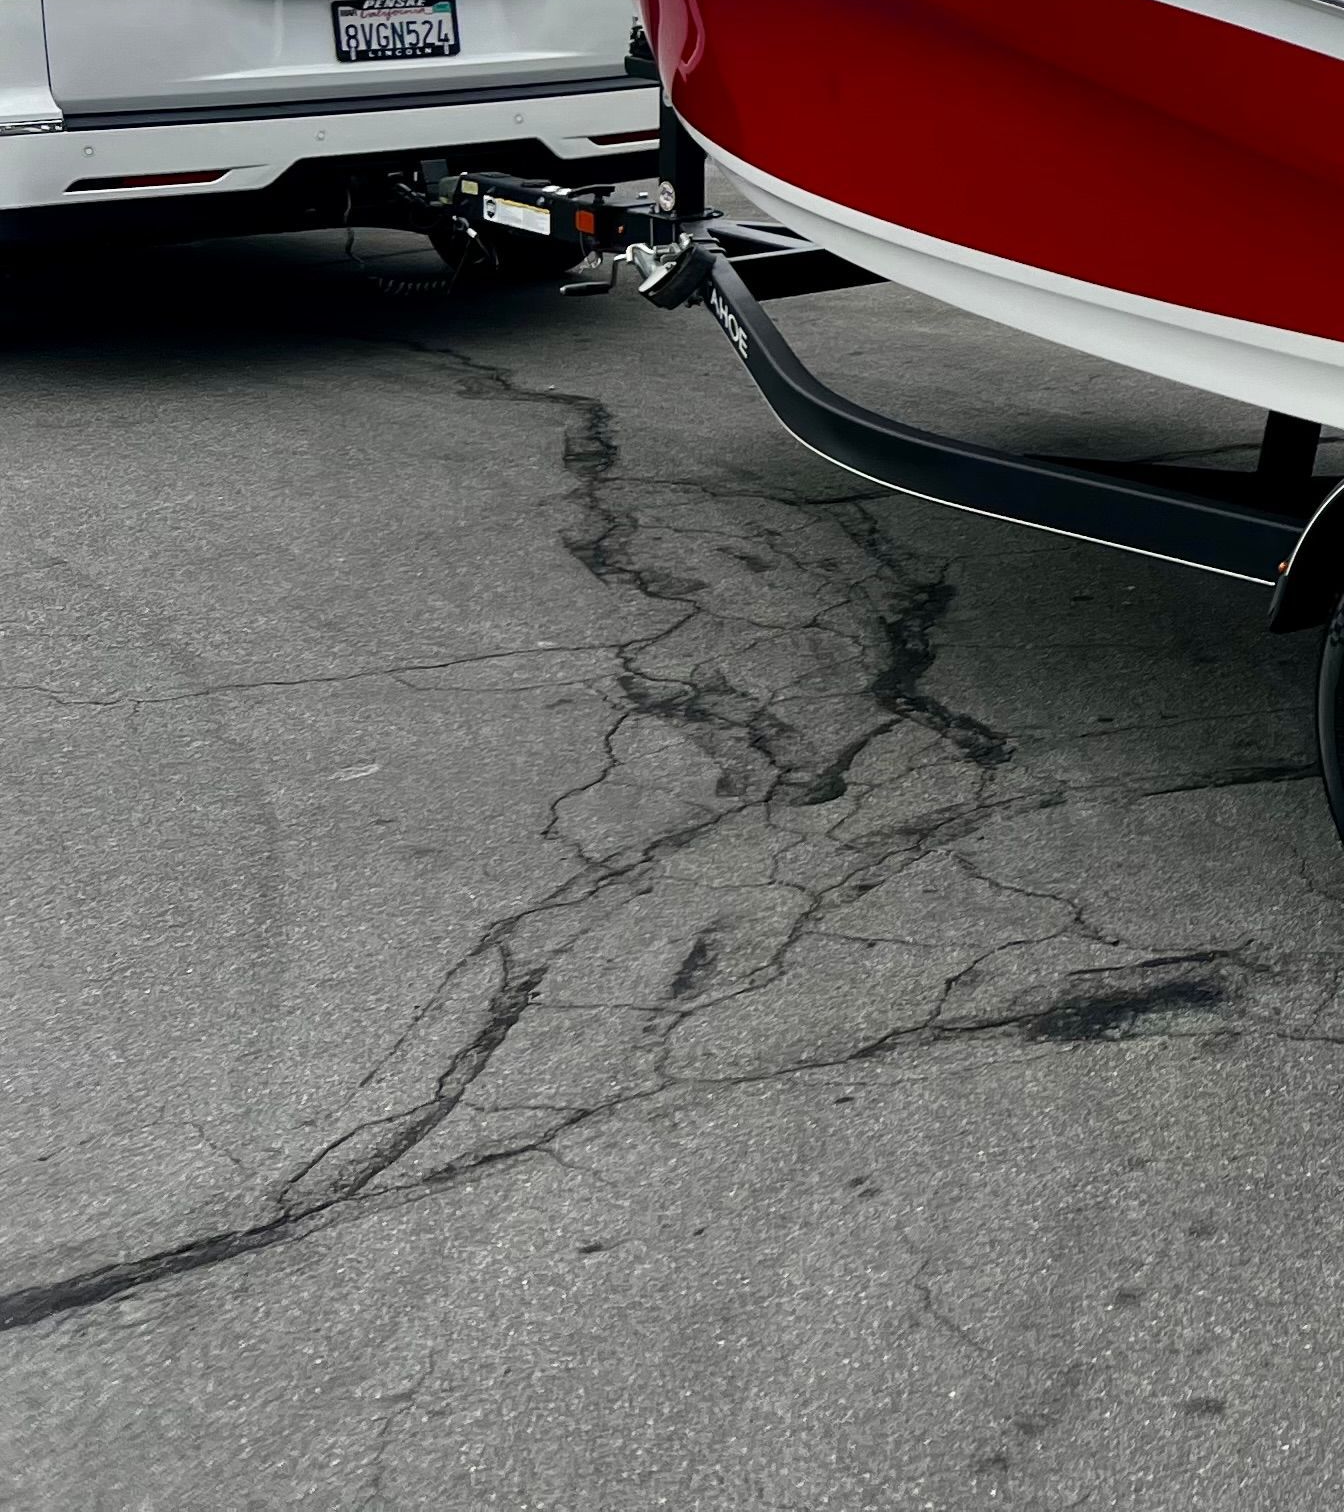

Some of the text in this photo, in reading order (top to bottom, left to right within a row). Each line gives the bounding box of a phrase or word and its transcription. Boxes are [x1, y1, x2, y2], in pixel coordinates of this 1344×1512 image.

[345, 20, 450, 49] 8VGN524
[368, 48, 433, 58] LINCOLN
[709, 282, 748, 359] AHOE
